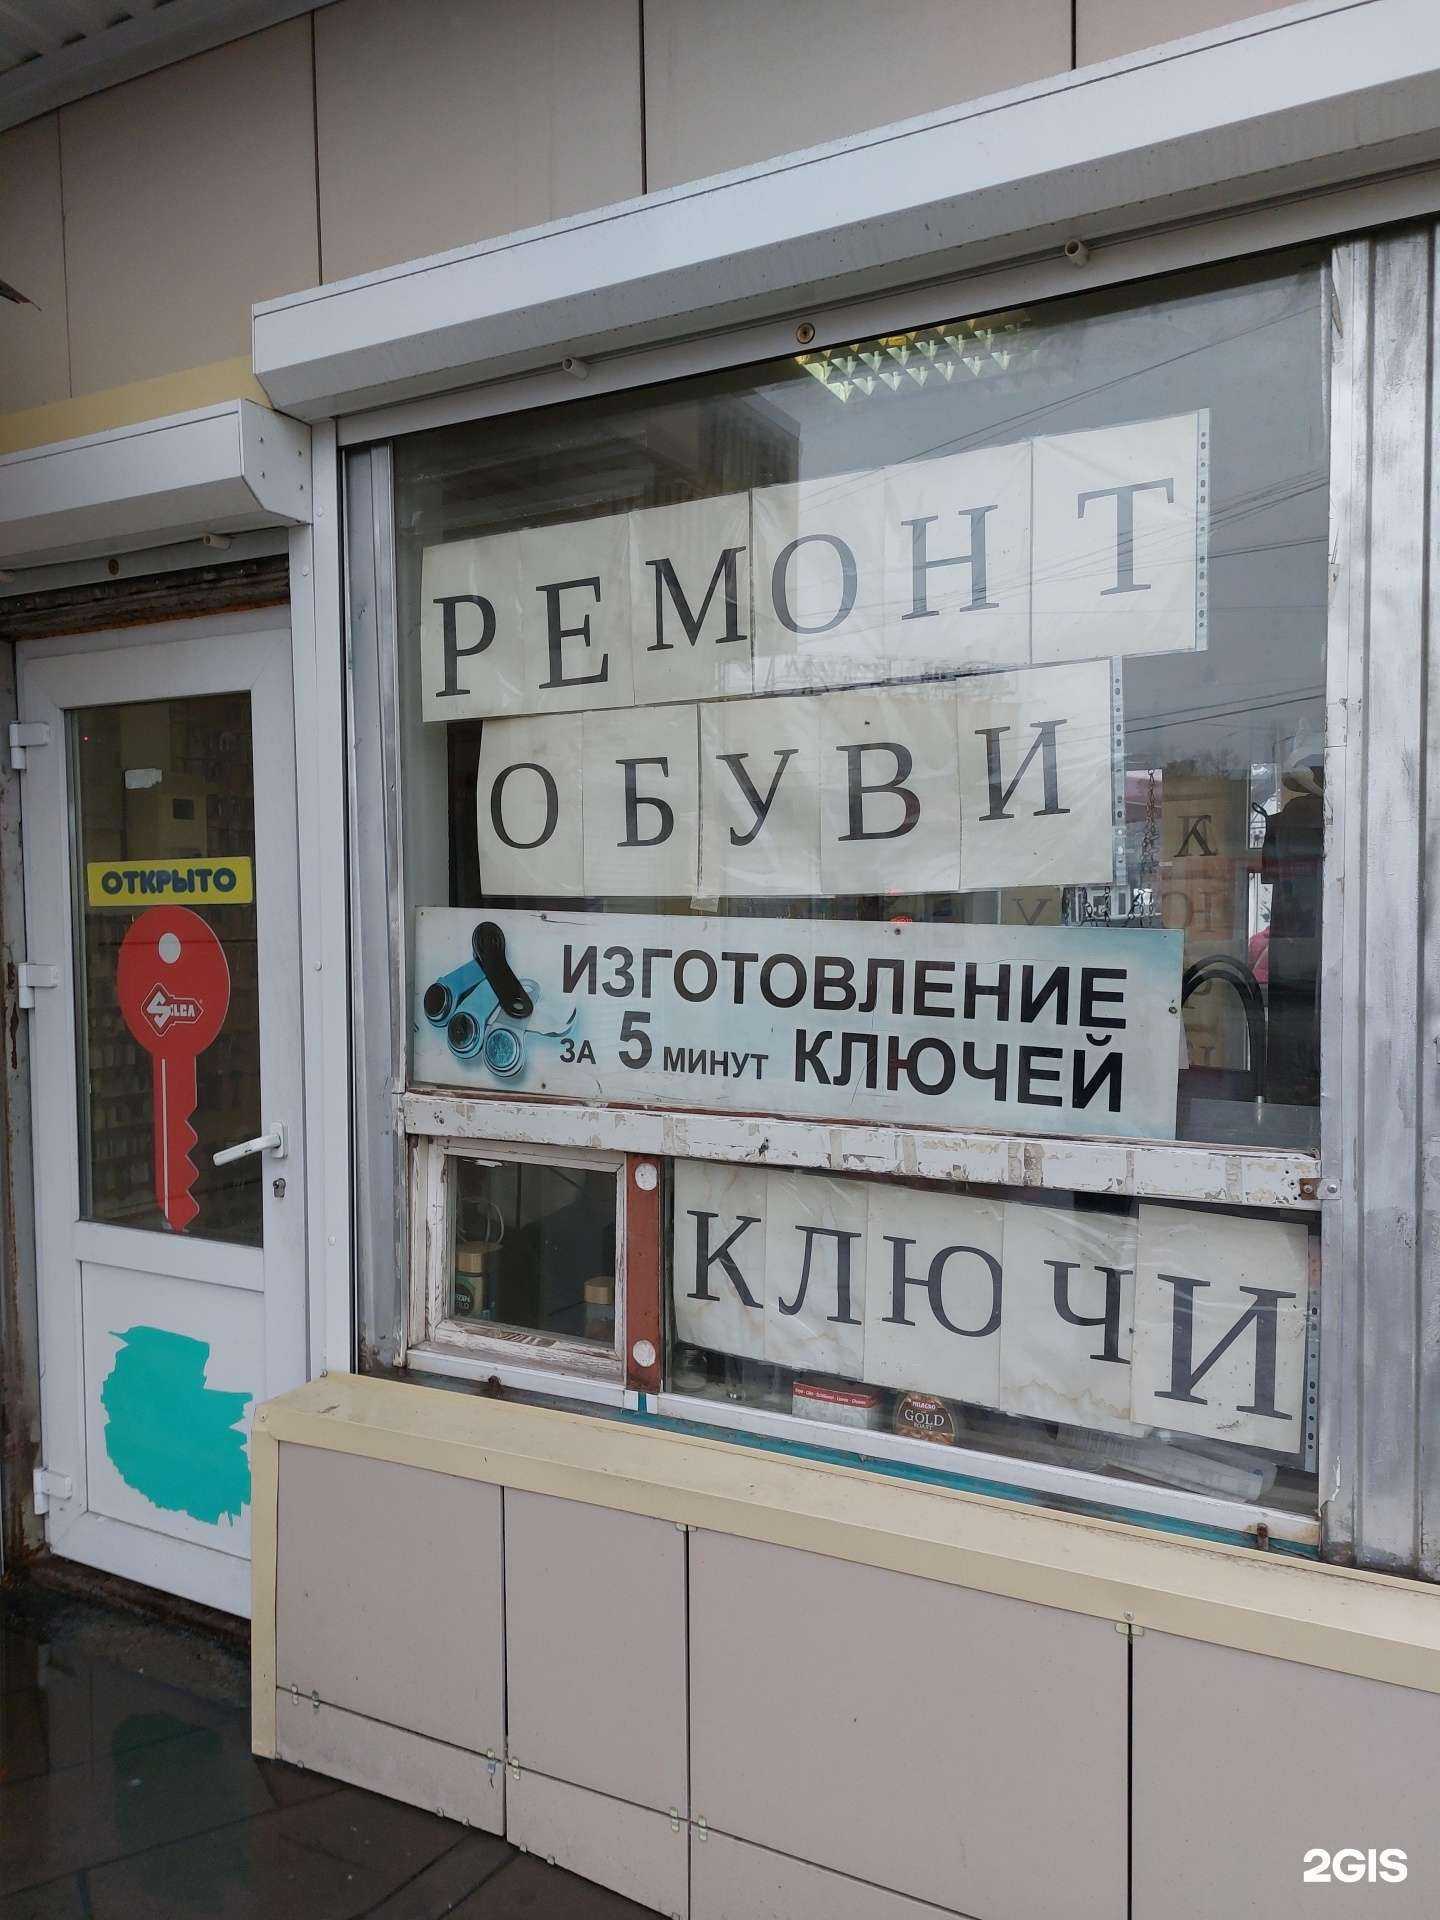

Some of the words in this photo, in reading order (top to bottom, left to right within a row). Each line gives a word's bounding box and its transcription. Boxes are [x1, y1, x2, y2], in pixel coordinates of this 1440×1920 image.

[433, 477, 1175, 698] РЕМОНТ
[489, 718, 1072, 851] ОБУВИ
[101, 867, 237, 895] ОТКРЫТО
[146, 990, 196, 1029] SILCA
[561, 943, 1128, 1030] ИЗГОТОВЛЕНИЕ
[559, 1037, 597, 1066] ЗА
[617, 1010, 654, 1071] 5
[662, 1047, 770, 1081] МИНУТ
[794, 1028, 1123, 1114] КЛЮЧЕЙ
[686, 1209, 1298, 1422] КЛЮЧИ
[904, 1409, 944, 1426] GOLD
